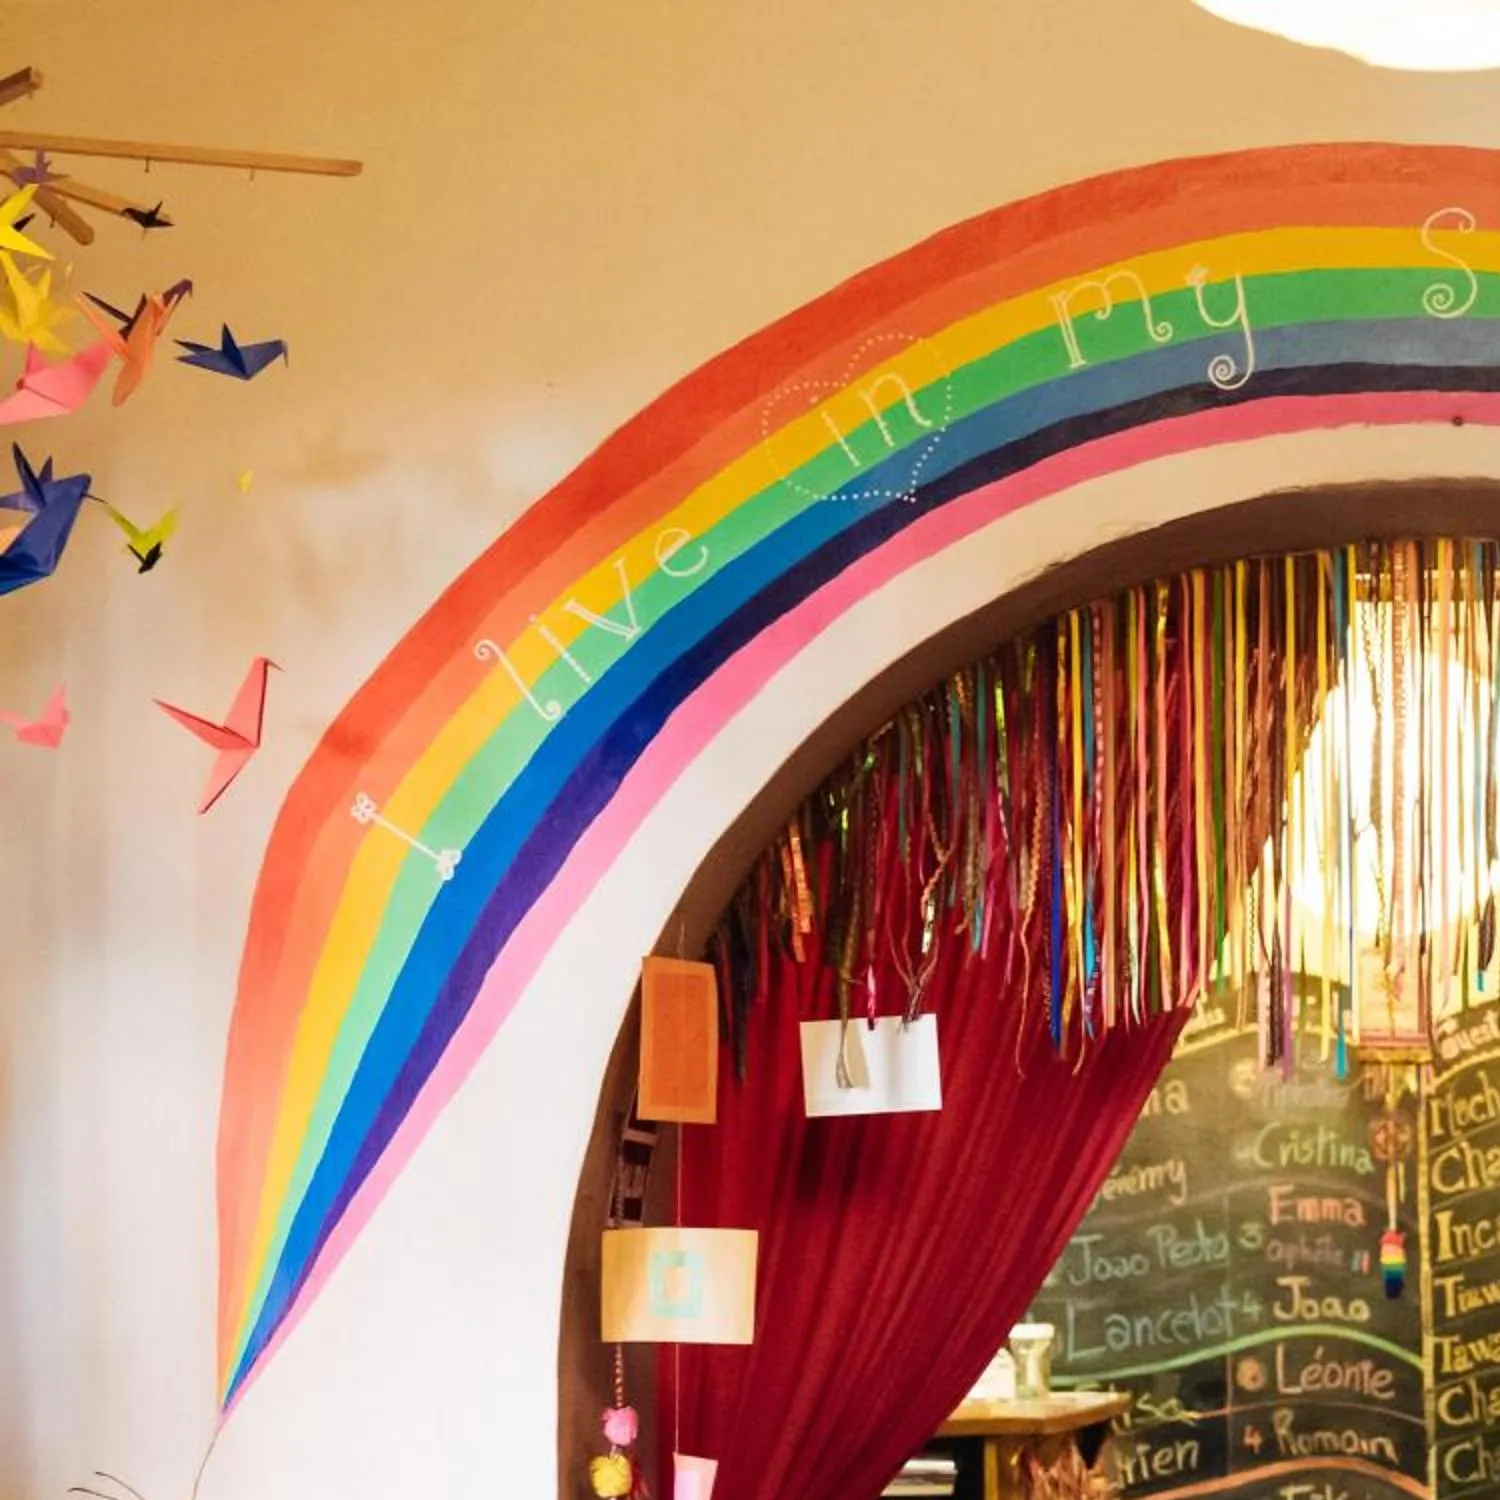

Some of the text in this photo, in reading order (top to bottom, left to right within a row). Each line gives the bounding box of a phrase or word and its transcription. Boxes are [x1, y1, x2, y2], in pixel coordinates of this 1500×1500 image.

[809, 372, 932, 467] in
[1050, 263, 1256, 391] my
[1253, 1120, 1375, 1175] Cristina
[1267, 1183, 1366, 1228] Emma
[1066, 1283, 1239, 1363] Lancelot
[1272, 1274, 1372, 1324] Joao
[1275, 1343, 1396, 1399] Léonie
[1273, 1407, 1400, 1465] Romain
